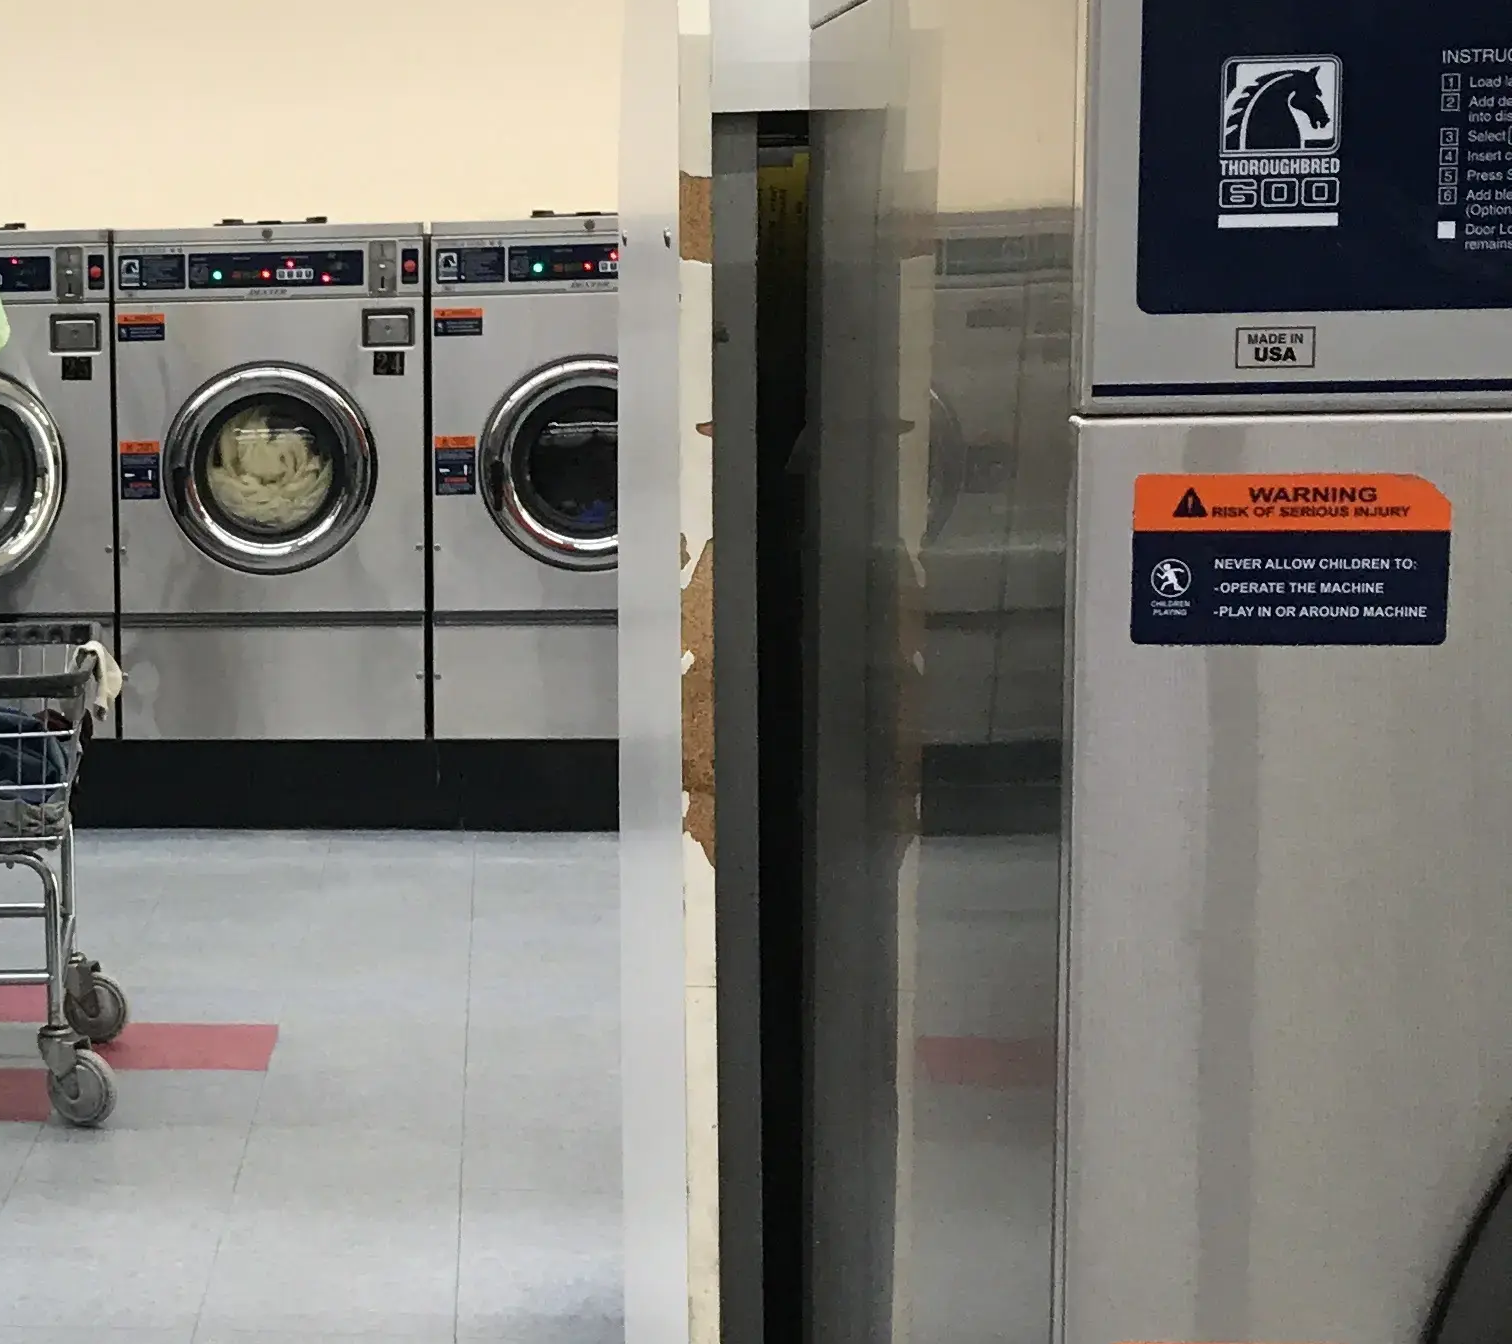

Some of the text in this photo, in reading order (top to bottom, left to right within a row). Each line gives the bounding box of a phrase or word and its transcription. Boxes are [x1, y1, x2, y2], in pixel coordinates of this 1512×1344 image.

[1448, 77, 1501, 88] 1 Load
[1446, 96, 1495, 108] 2 Add
[1469, 111, 1491, 122] into
[1446, 131, 1506, 142] 3 Select
[1444, 150, 1501, 161] 4 Insert
[1220, 158, 1340, 176] THOROUGHBRED
[1444, 170, 1503, 182] 5 Press
[1219, 177, 1340, 208] 600
[1444, 190, 1491, 201] 6 Add
[1466, 224, 1496, 235] Door
[1248, 333, 1303, 345] MADE IN
[1254, 346, 1297, 362] USA
[376, 353, 401, 374] 24
[1248, 487, 1377, 503] WARNING
[1212, 506, 1410, 518] RISK OF SERIOUS INJURY
[1215, 558, 1418, 570] NEVER ALLOW CHILDREN TO:
[1214, 582, 1384, 594] -OPERATE THE MACHINE
[1214, 606, 1427, 618] -PLAY IN OR AROUND MACHINE
